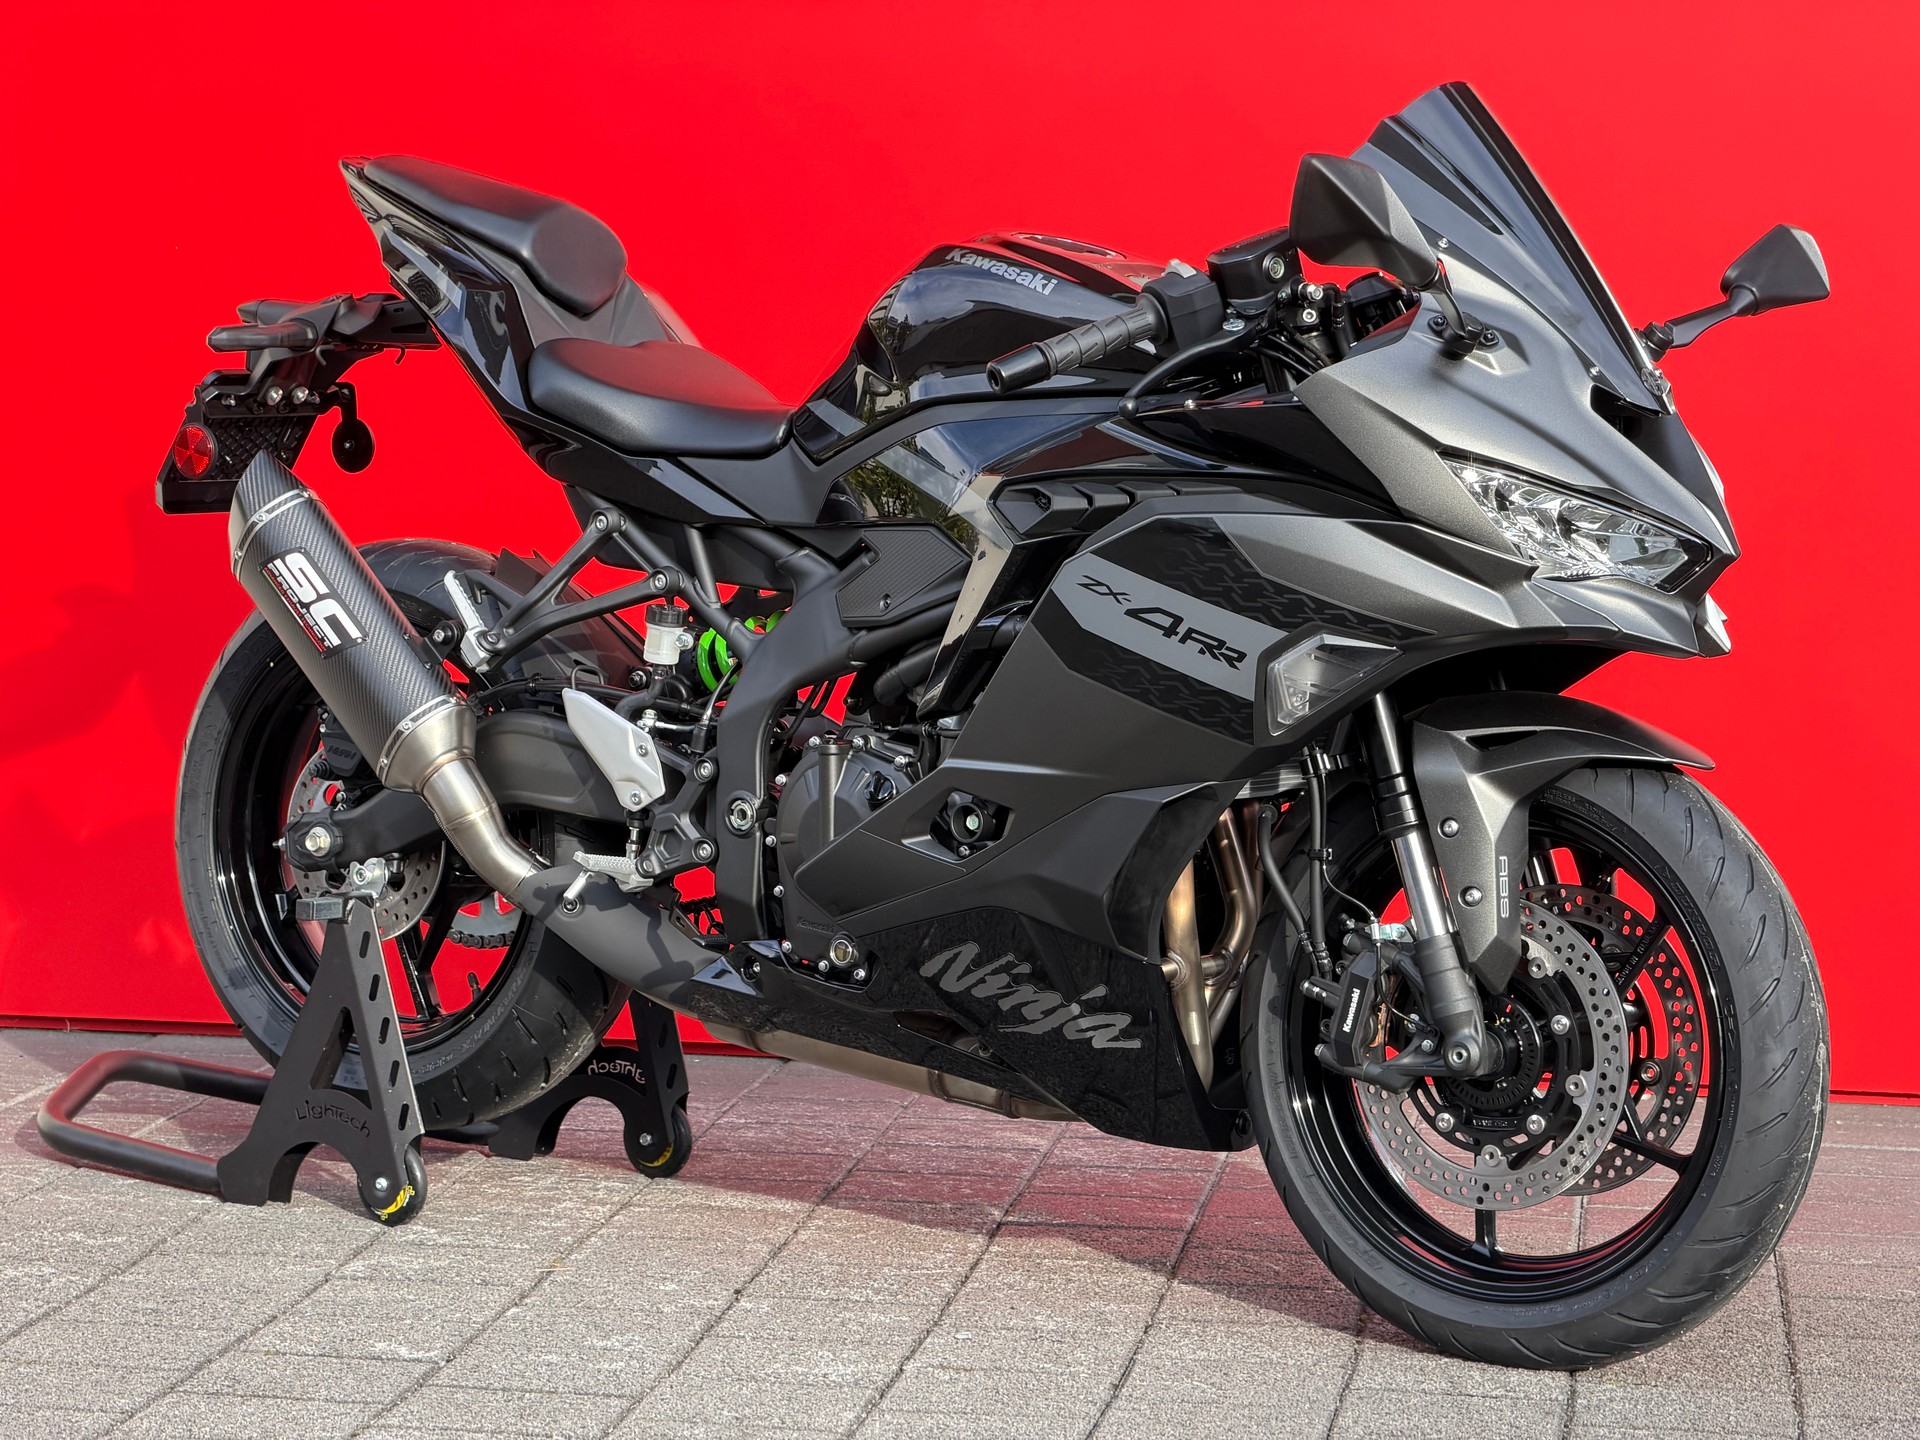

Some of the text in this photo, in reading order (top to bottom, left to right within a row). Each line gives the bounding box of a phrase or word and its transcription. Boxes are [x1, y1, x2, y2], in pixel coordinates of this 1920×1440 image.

[945, 247, 1058, 296] Kawasaki
[267, 562, 333, 649] PROJECT
[273, 552, 363, 648] SC
[1499, 855, 1510, 918] ABS
[919, 941, 1142, 1049] Ninja
[1342, 987, 1361, 1033] Kawasaki
[295, 1099, 371, 1138] LighTech
